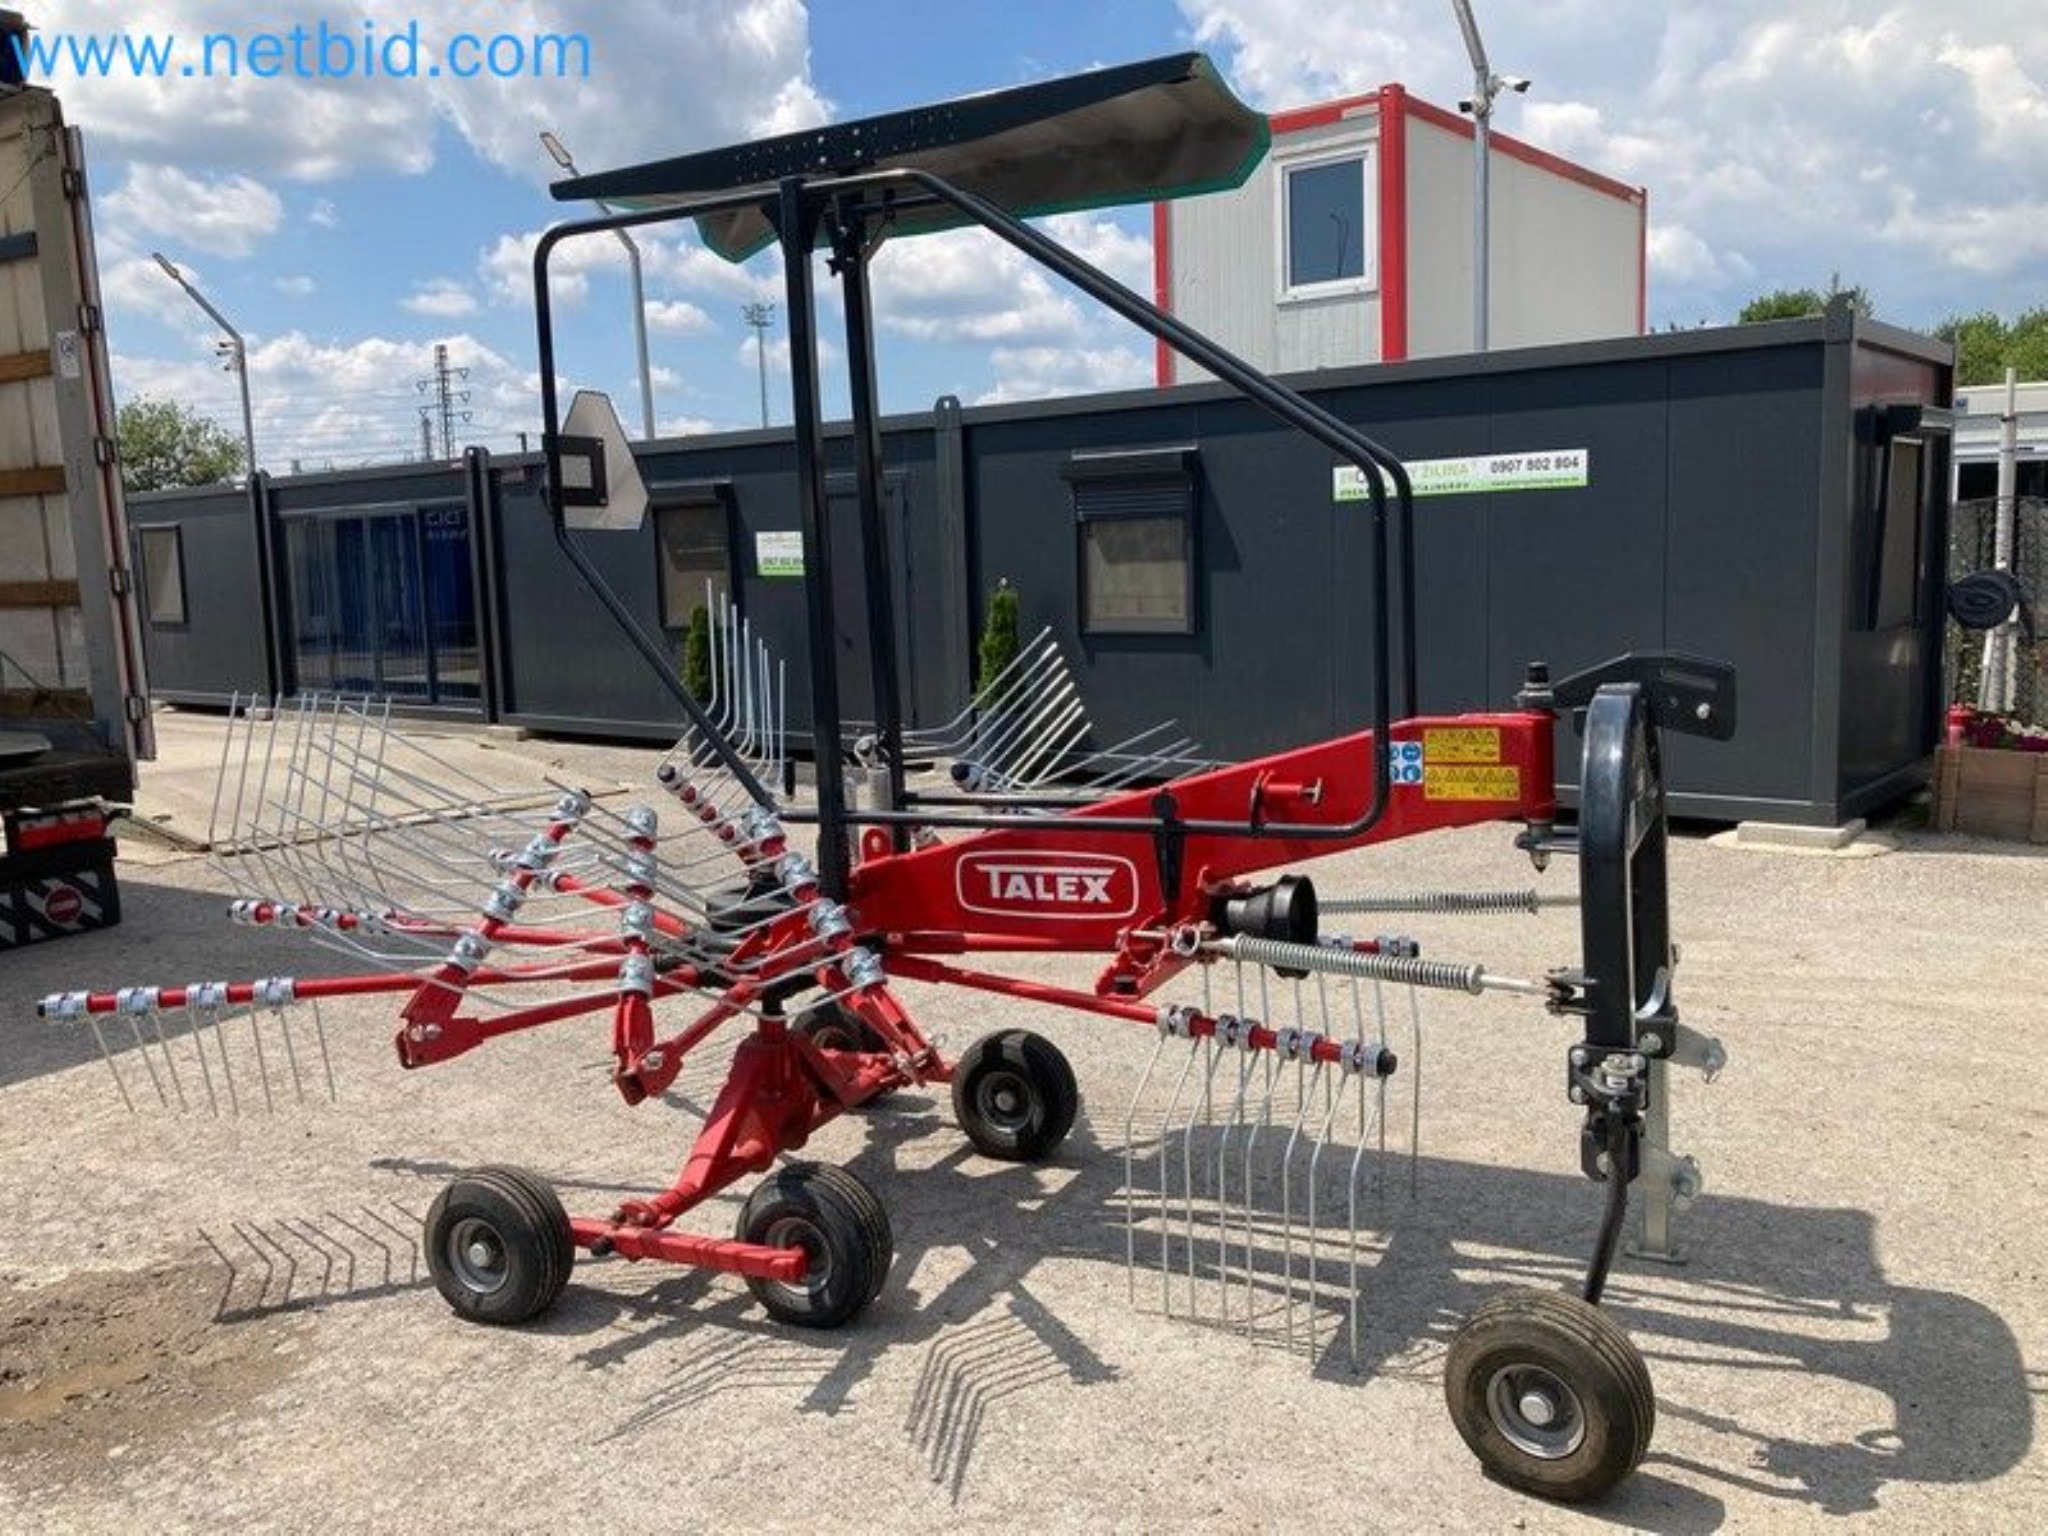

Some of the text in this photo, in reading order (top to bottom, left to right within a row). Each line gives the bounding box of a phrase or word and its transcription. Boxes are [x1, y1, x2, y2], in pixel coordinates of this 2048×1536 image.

[1490, 455, 1580, 474] 0907 802 804
[974, 864, 1116, 904] TALEX
